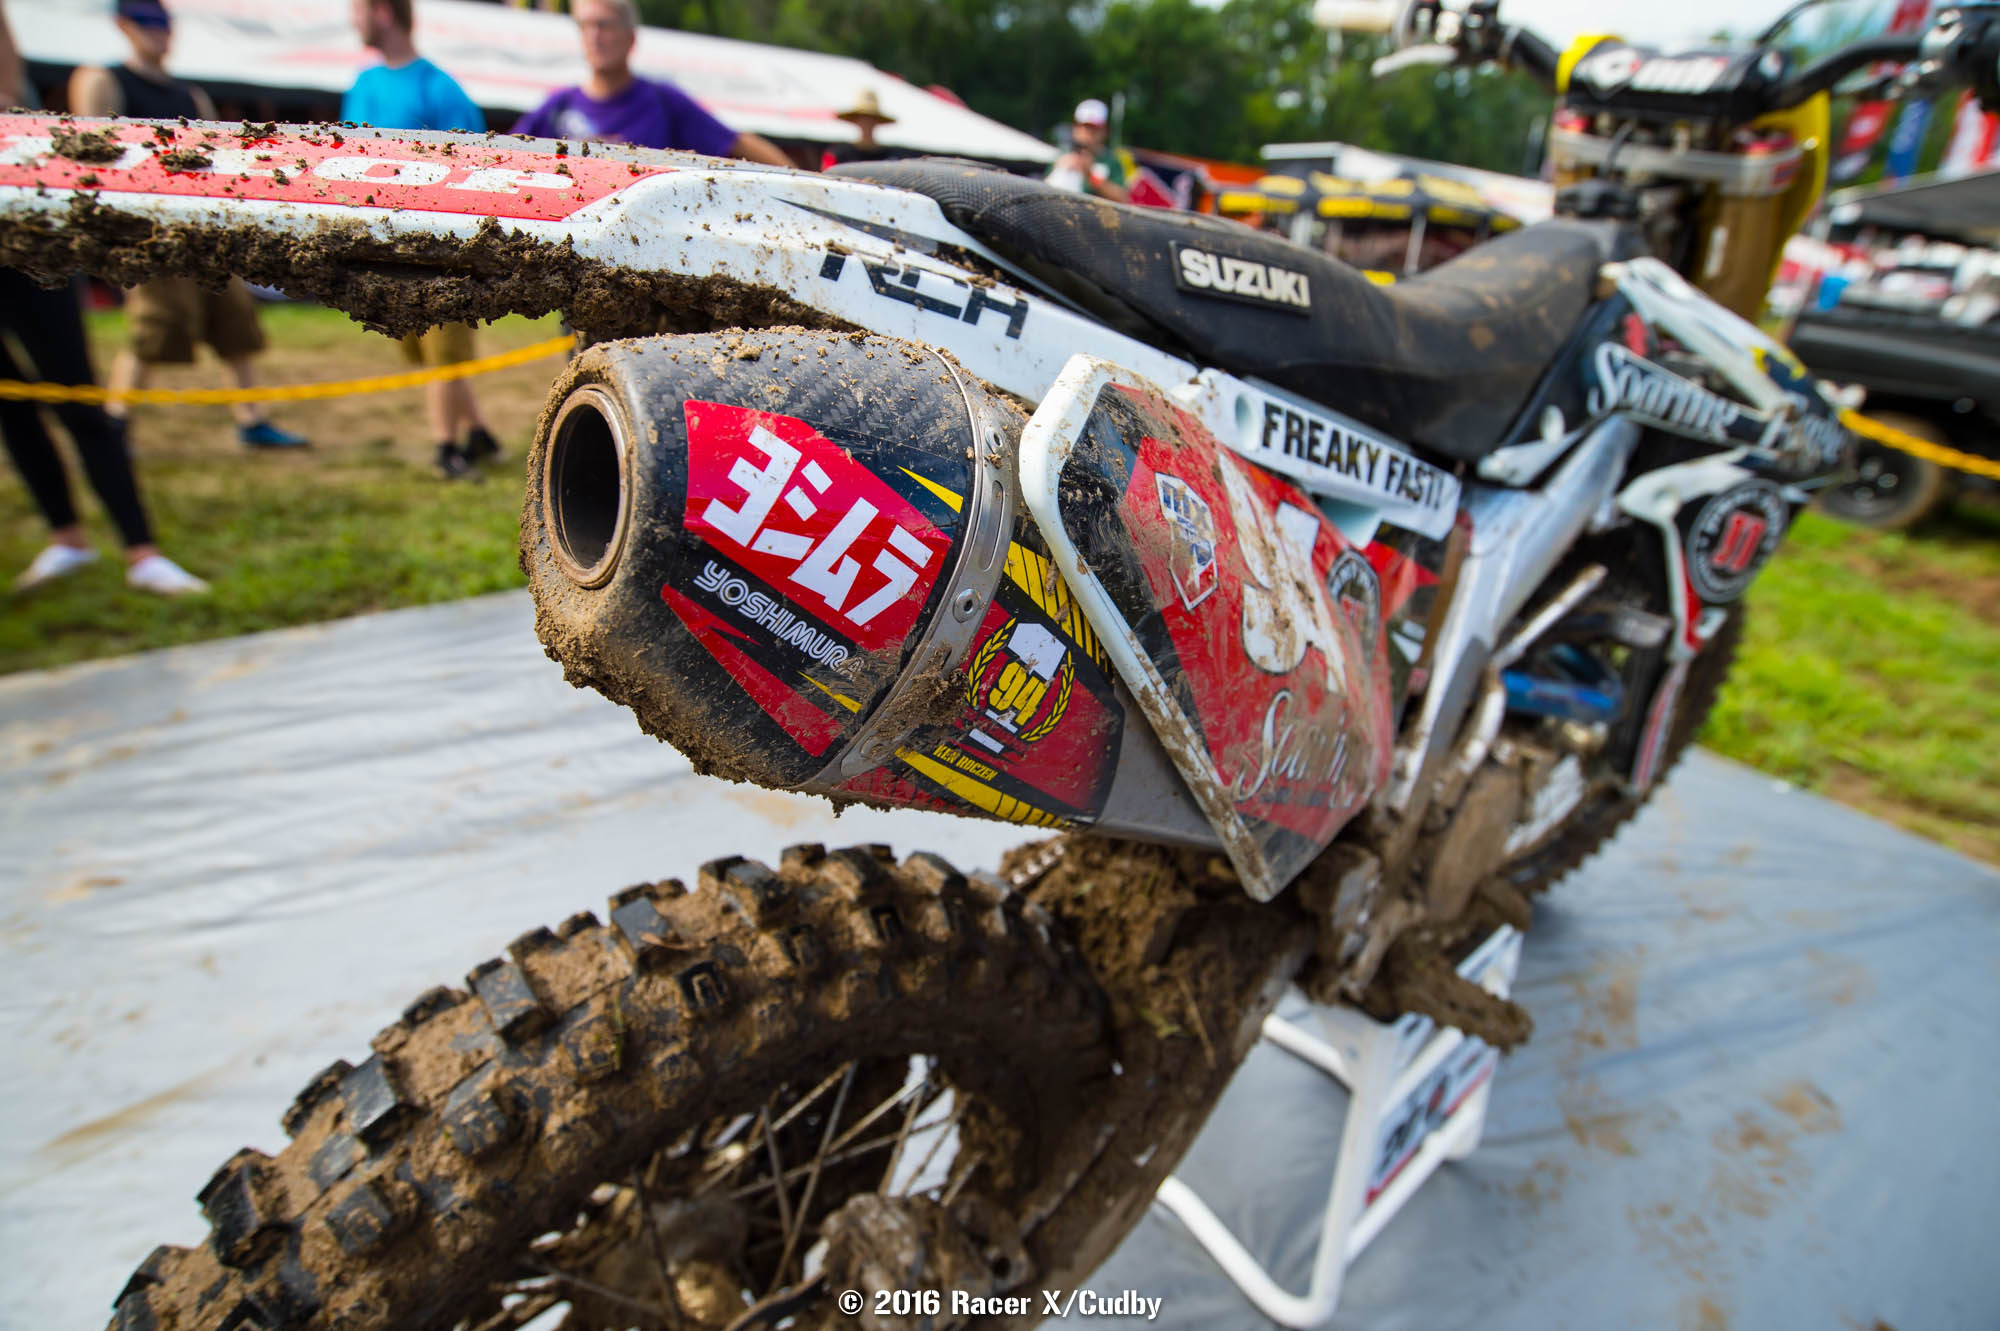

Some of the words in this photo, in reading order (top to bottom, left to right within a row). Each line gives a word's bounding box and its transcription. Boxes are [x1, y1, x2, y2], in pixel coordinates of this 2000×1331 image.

[1180, 248, 1311, 307] SUZUKI
[1262, 402, 1381, 486] FREAKY
[1384, 454, 1445, 511] FAST!
[701, 424, 934, 627] ヨシムラ
[693, 559, 865, 672] YOSHIMURA
[988, 661, 1049, 727] 94
[932, 744, 961, 764] KEN
[955, 755, 999, 782] ROCZEN
